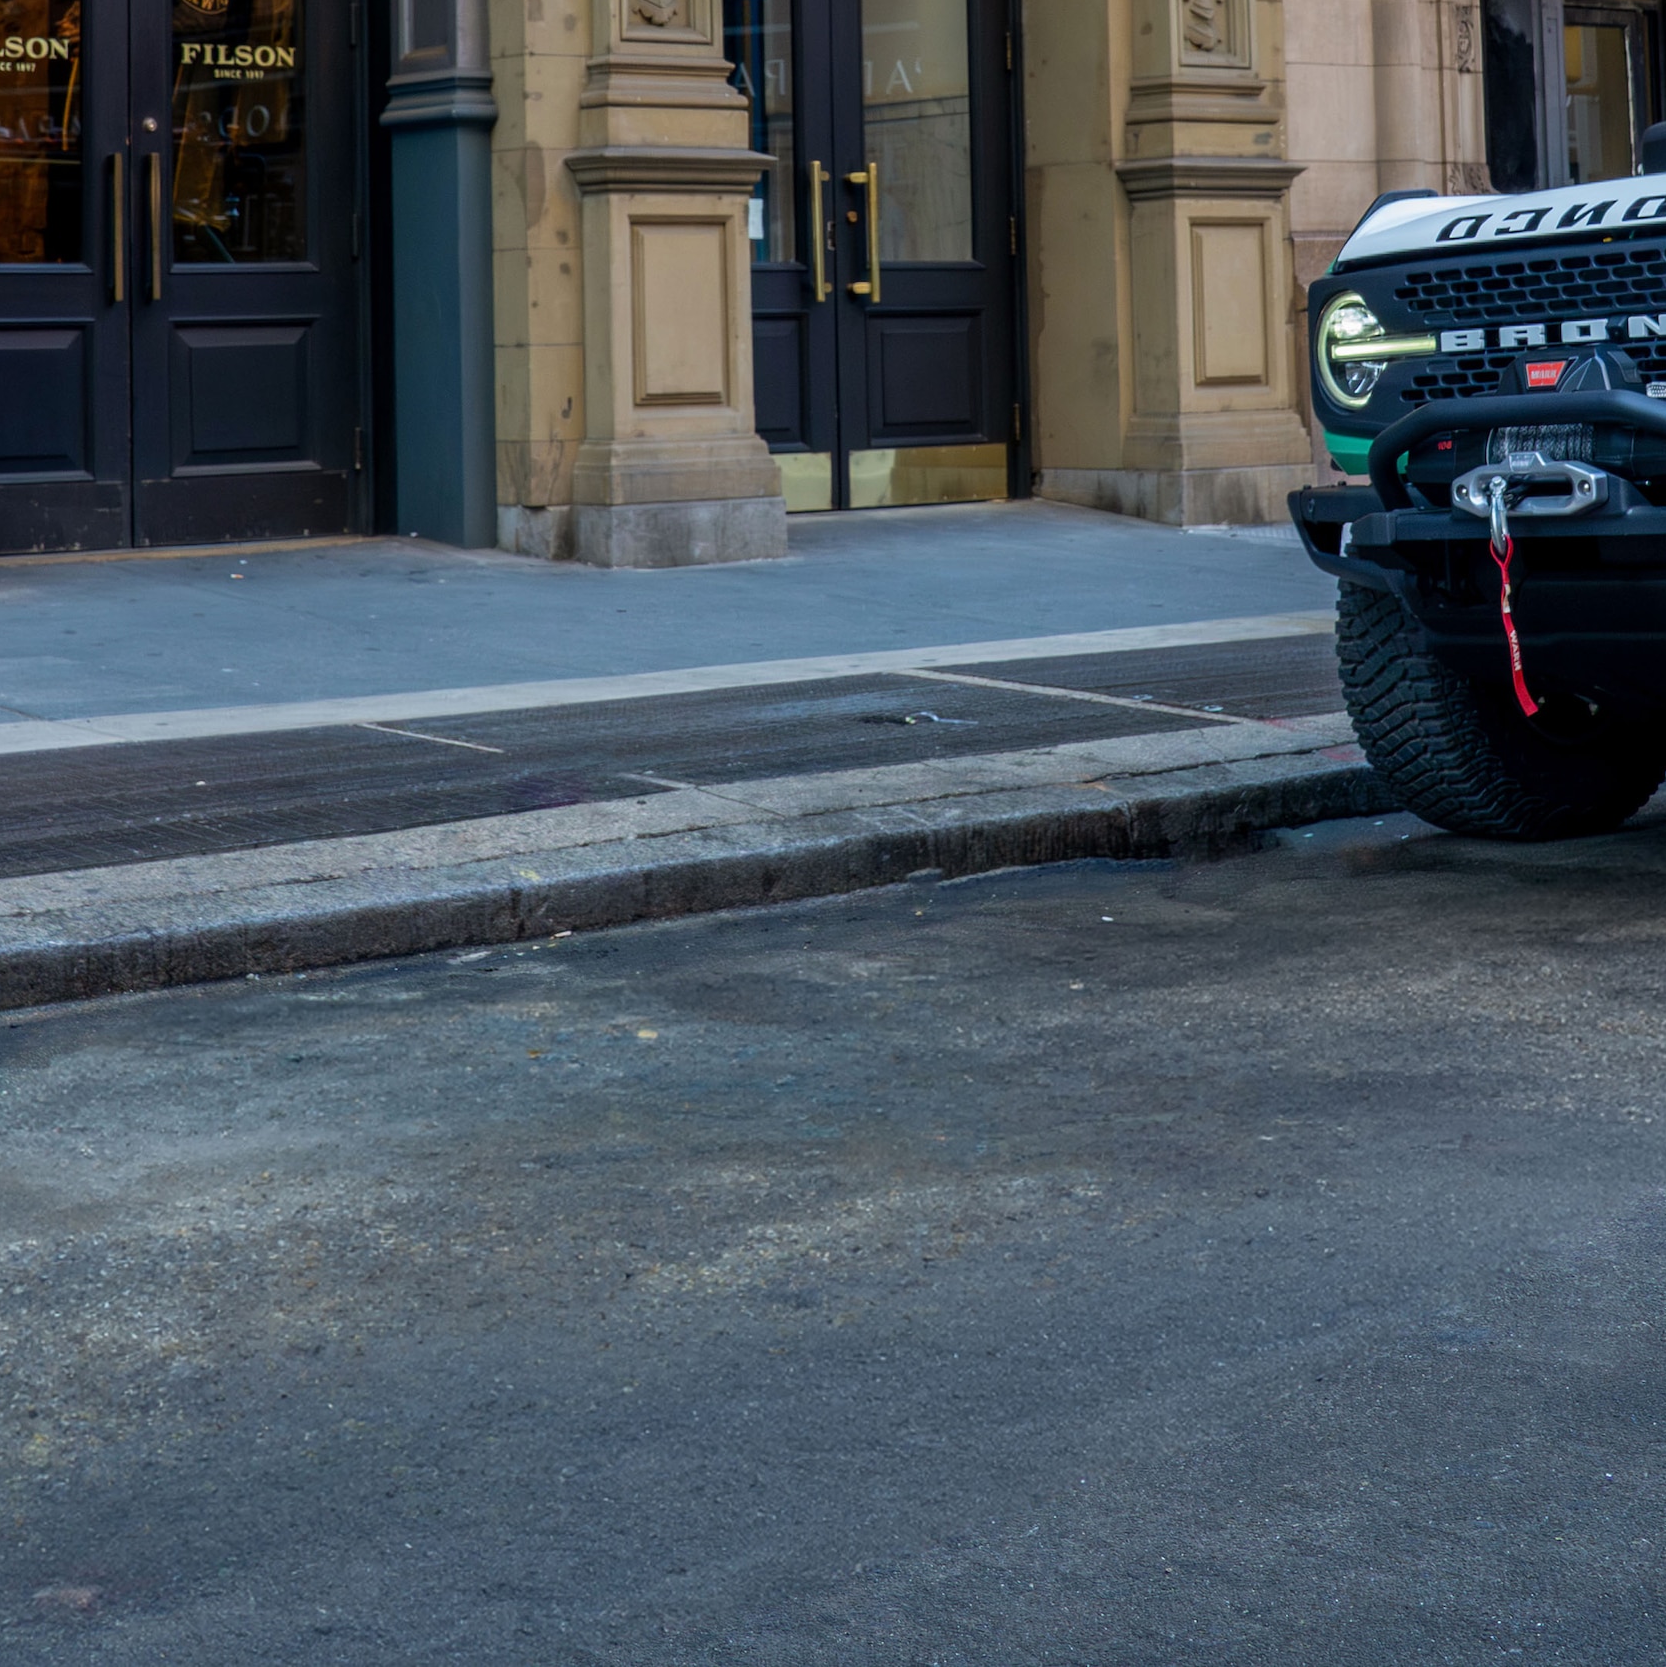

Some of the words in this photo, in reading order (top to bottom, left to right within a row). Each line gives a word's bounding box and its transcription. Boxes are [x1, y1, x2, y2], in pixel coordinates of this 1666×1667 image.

[181, 42, 297, 68] FILSON
[214, 68, 242, 80] SINCE
[1510, 630, 1522, 671] WARN
